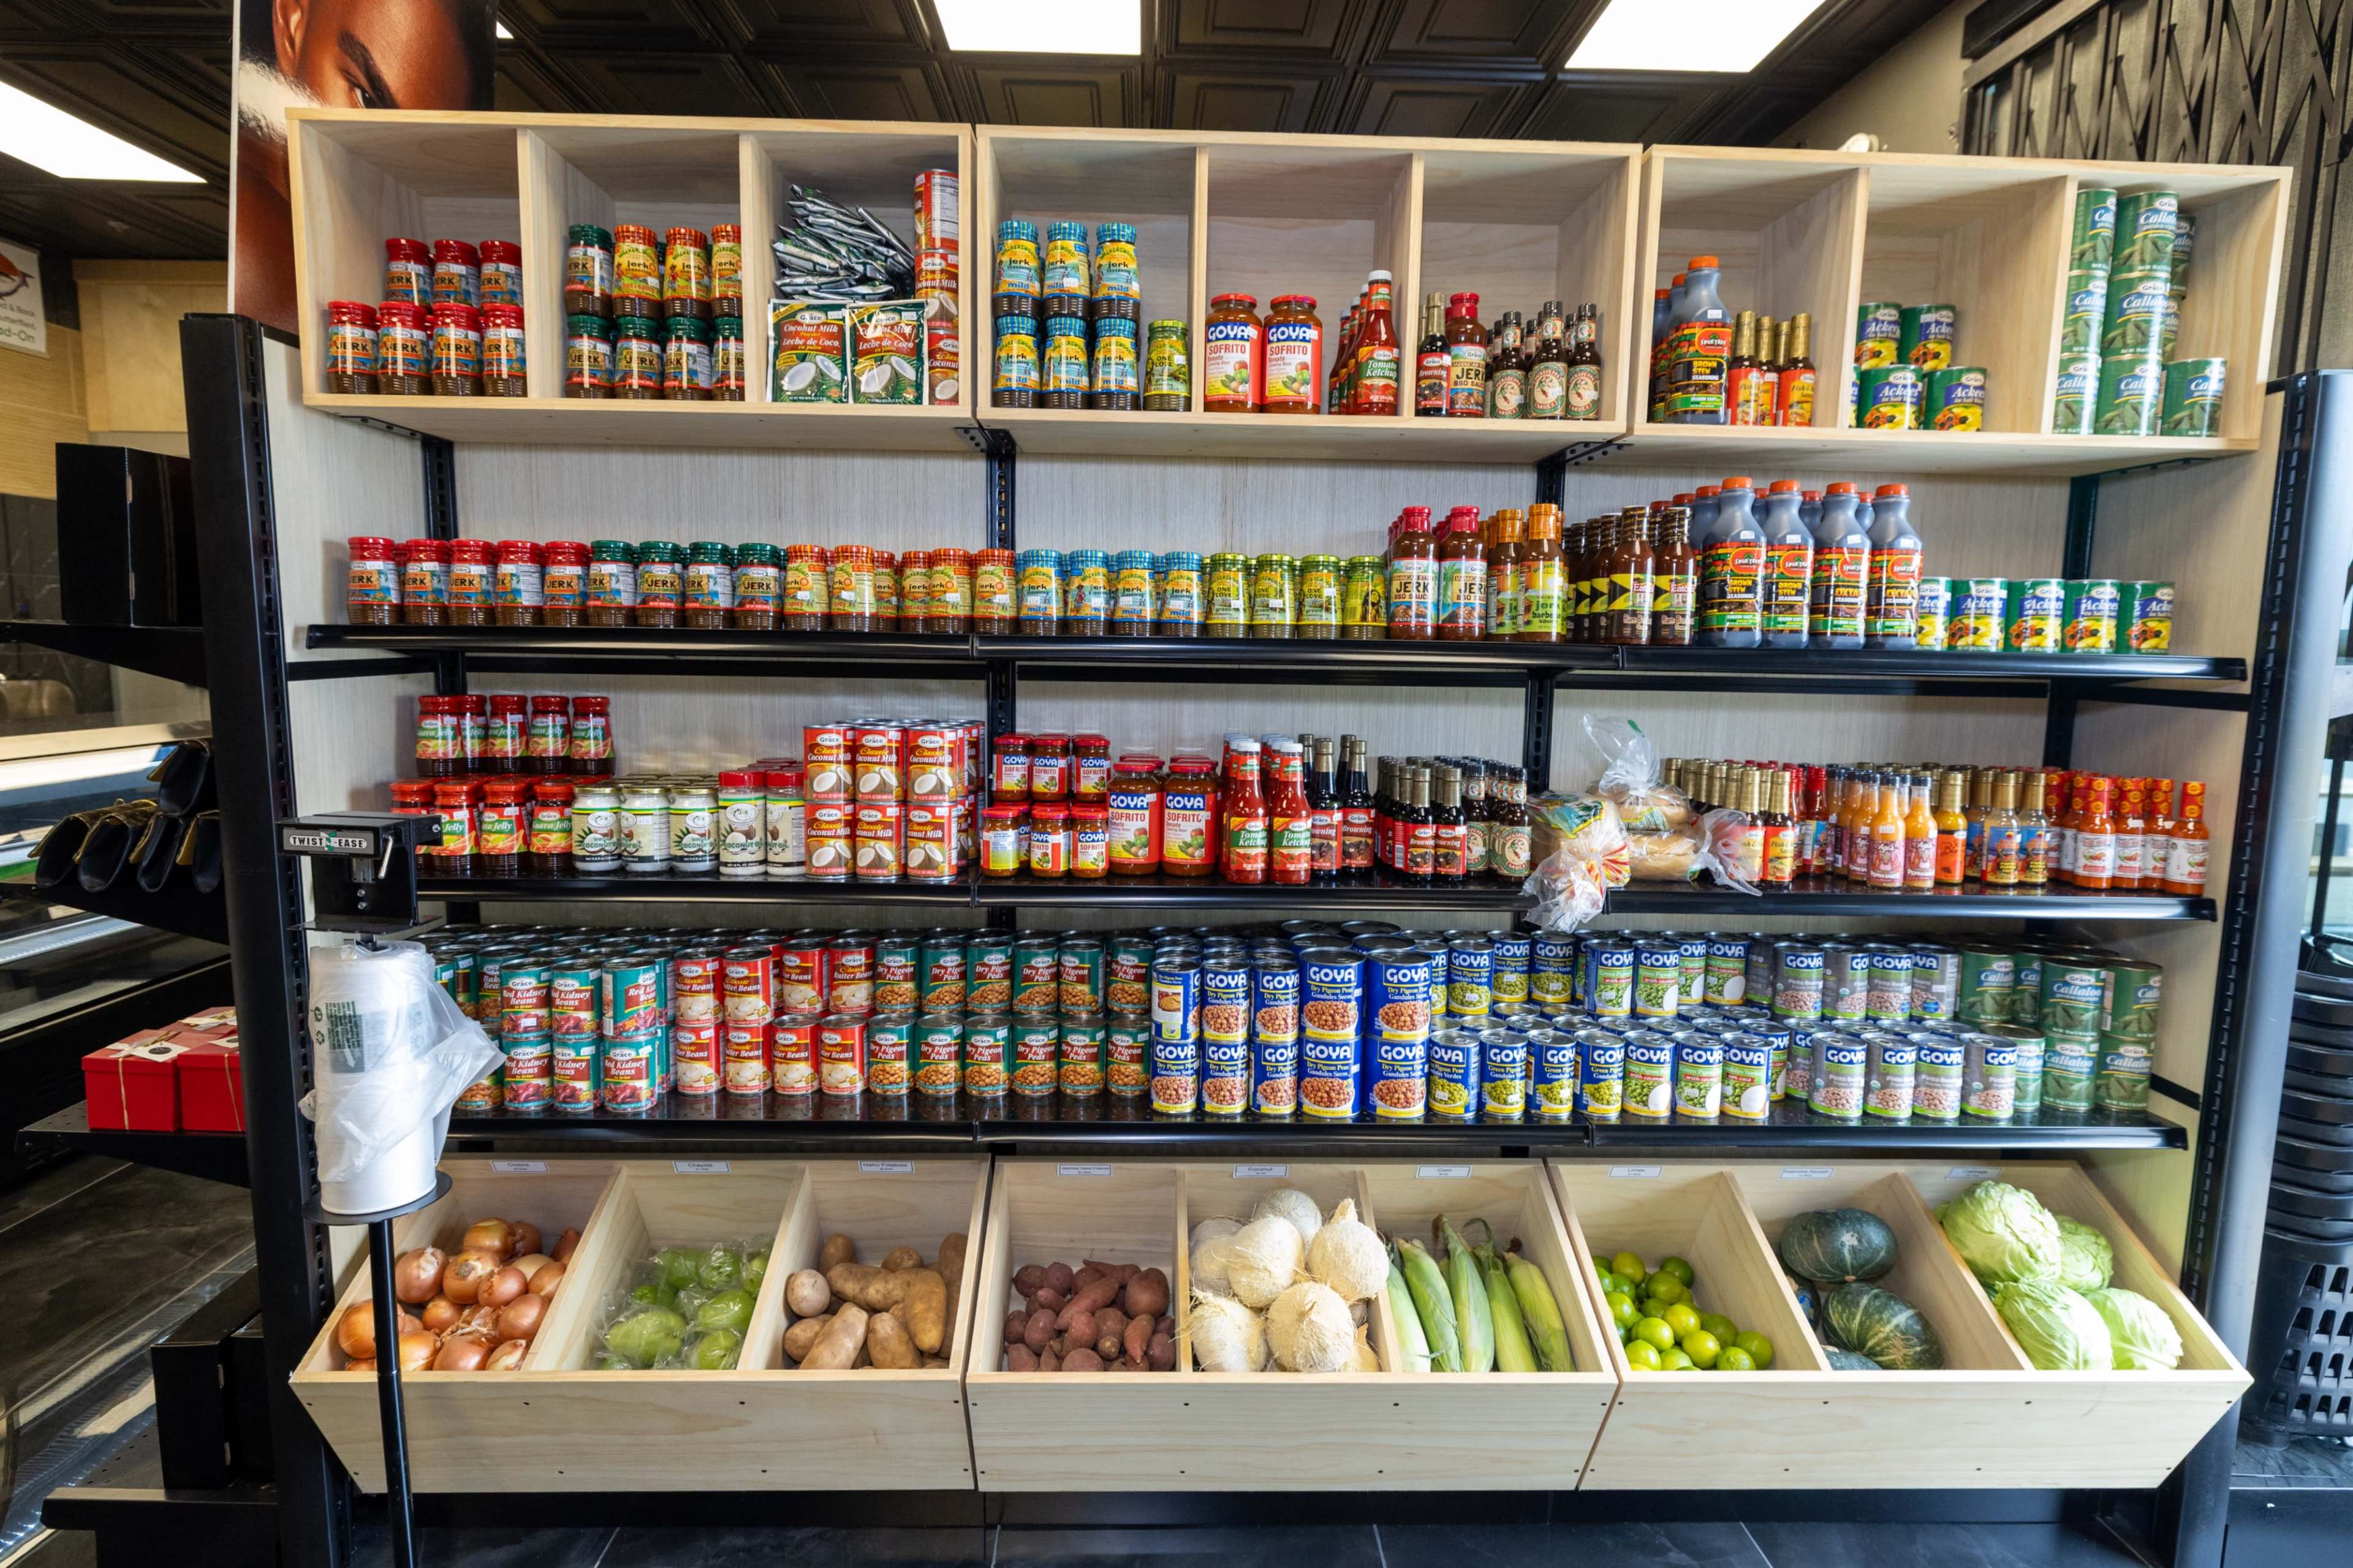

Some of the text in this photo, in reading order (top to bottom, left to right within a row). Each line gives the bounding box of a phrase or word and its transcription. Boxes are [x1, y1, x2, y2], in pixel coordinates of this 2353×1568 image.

[1009, 257, 1029, 267] jerk
[940, 280, 957, 289] Milk
[784, 324, 838, 333] Coconut Milk
[1208, 326, 1250, 340] GOYA
[1268, 327, 1311, 341] GOYA
[782, 338, 805, 347] Leche
[819, 338, 839, 347] Coco
[859, 341, 881, 349] Leche
[894, 339, 914, 348] Coco
[1208, 344, 1246, 355] SOFRITO
[1269, 344, 1308, 356] SOFRITO
[1368, 360, 1397, 368] Tomato
[1366, 368, 1397, 379] Ketchup
[1419, 368, 1447, 377] Browning
[1879, 386, 1919, 397] Ackees
[450, 578, 476, 587] JERK
[547, 580, 573, 589] JERK
[648, 578, 676, 588] JERK
[744, 581, 771, 591] JERK
[909, 583, 928, 591] jerk
[1962, 598, 2003, 609] Ackees
[1109, 795, 1149, 808] GOYA
[1166, 796, 1204, 809] GOYA
[1110, 812, 1145, 822] SOFRITO
[445, 822, 464, 832] Jelly
[494, 822, 513, 831] Jelly
[292, 837, 324, 846] TWIST
[1536, 944, 1573, 956] GOYA
[1451, 953, 1490, 967] GOYA
[1641, 953, 1679, 966] GOYA
[1786, 956, 1823, 968] GOYA
[1873, 957, 1912, 969] GOYA
[1309, 967, 1355, 982] GOYA
[1386, 968, 1429, 983] GOYA
[1207, 974, 1246, 988] GOYA
[692, 983, 714, 991] Beans
[2053, 983, 2102, 996] Callaloo
[517, 988, 547, 998] Kidney
[561, 990, 591, 999] Kidney
[881, 1045, 907, 1053] Pigeon
[921, 1042, 959, 1053] Dry Pigeon
[1156, 1045, 1195, 1059] GOYA
[1208, 1045, 1247, 1059] GOYA
[1306, 1043, 1352, 1059] GOYA
[1380, 1045, 1425, 1060] GOYA
[1627, 1045, 1671, 1062] GOYA
[1827, 1050, 1866, 1064] GOYA
[1920, 1050, 1961, 1064] GOYA
[518, 1058, 548, 1067] Kidney
[2044, 1053, 2093, 1067] Callaloo
